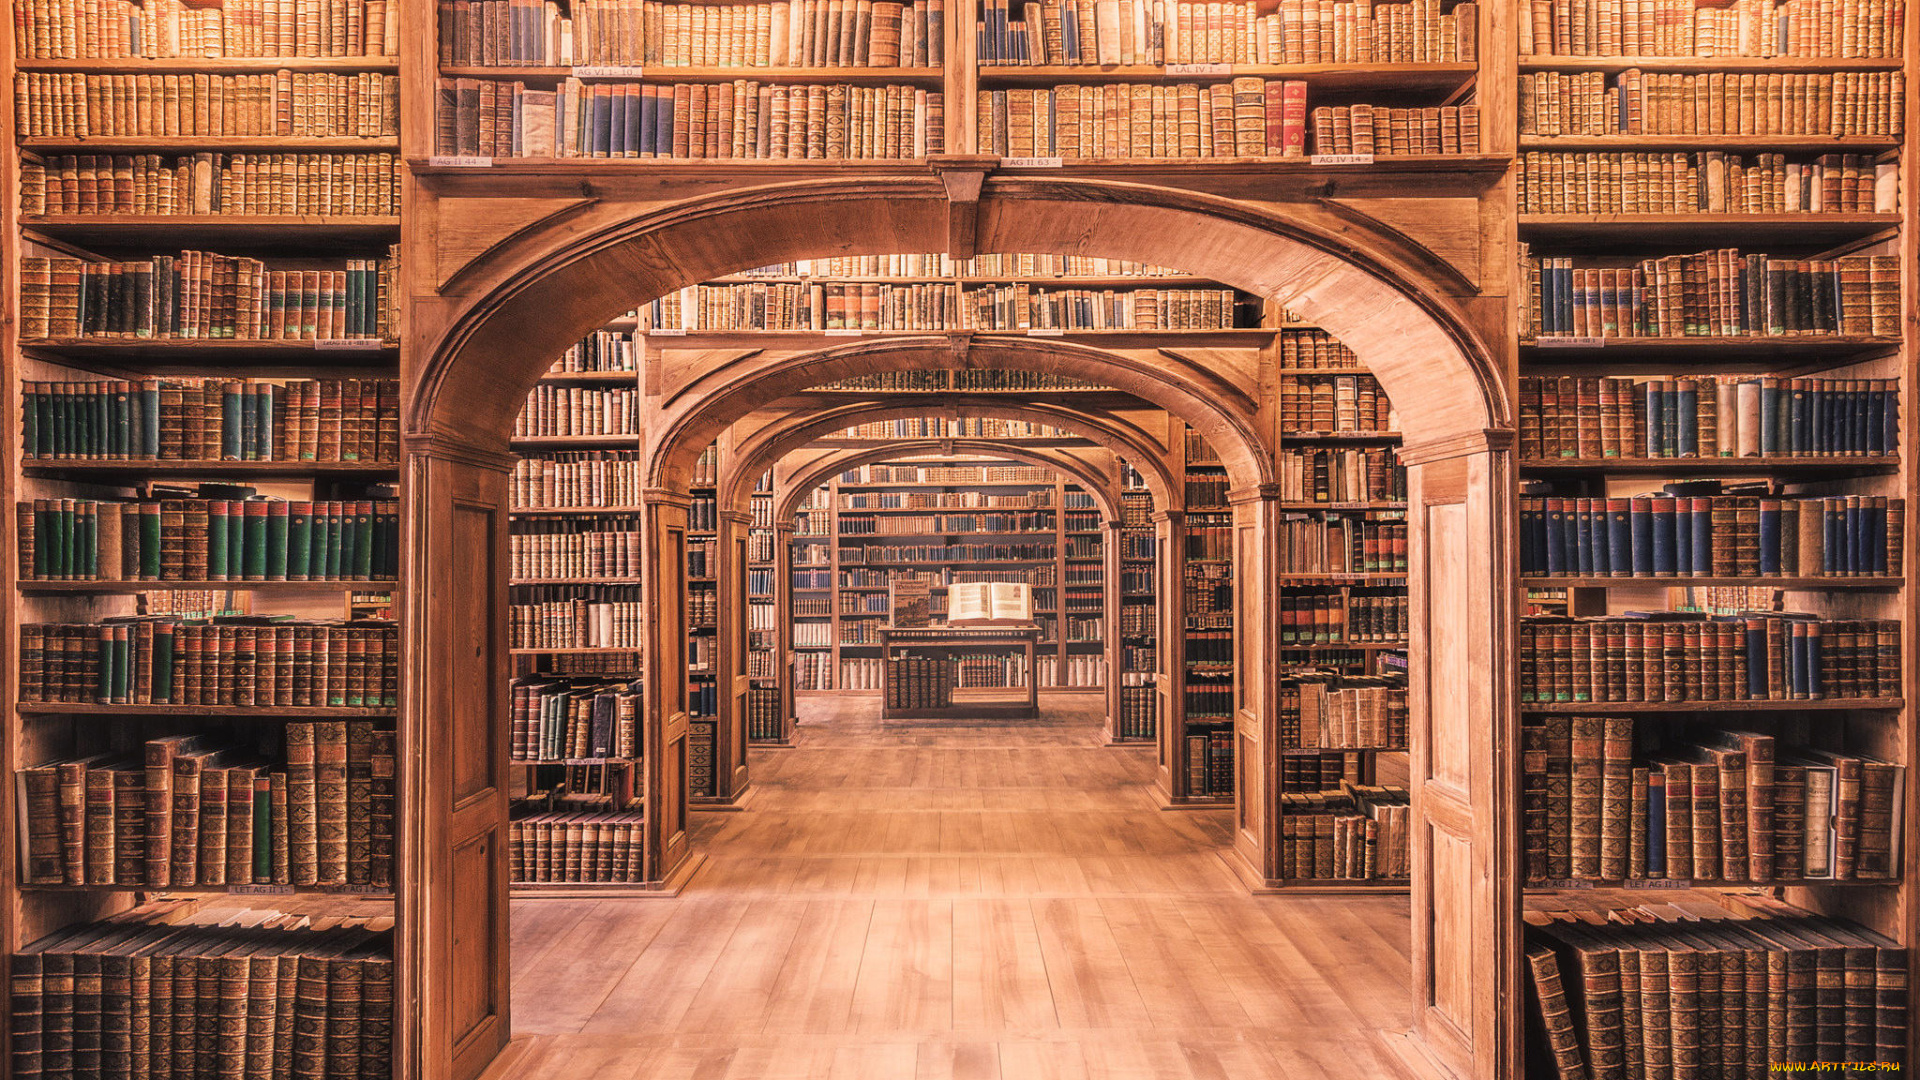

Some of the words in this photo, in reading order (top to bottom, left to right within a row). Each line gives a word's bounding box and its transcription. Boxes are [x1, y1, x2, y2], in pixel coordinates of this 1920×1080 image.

[436, 157, 451, 165] AG
[454, 157, 462, 165] II
[464, 157, 477, 165] 44
[1009, 158, 1024, 166] AG
[1026, 158, 1034, 166] II
[1037, 158, 1050, 166] 63
[1552, 880, 1565, 888] AG
[1630, 880, 1645, 888] LET
[1648, 880, 1662, 888] AG
[1664, 880, 1672, 888] II
[234, 885, 251, 893] LET
[253, 885, 267, 893] AG
[268, 885, 277, 893] II
[350, 885, 363, 893] AG
